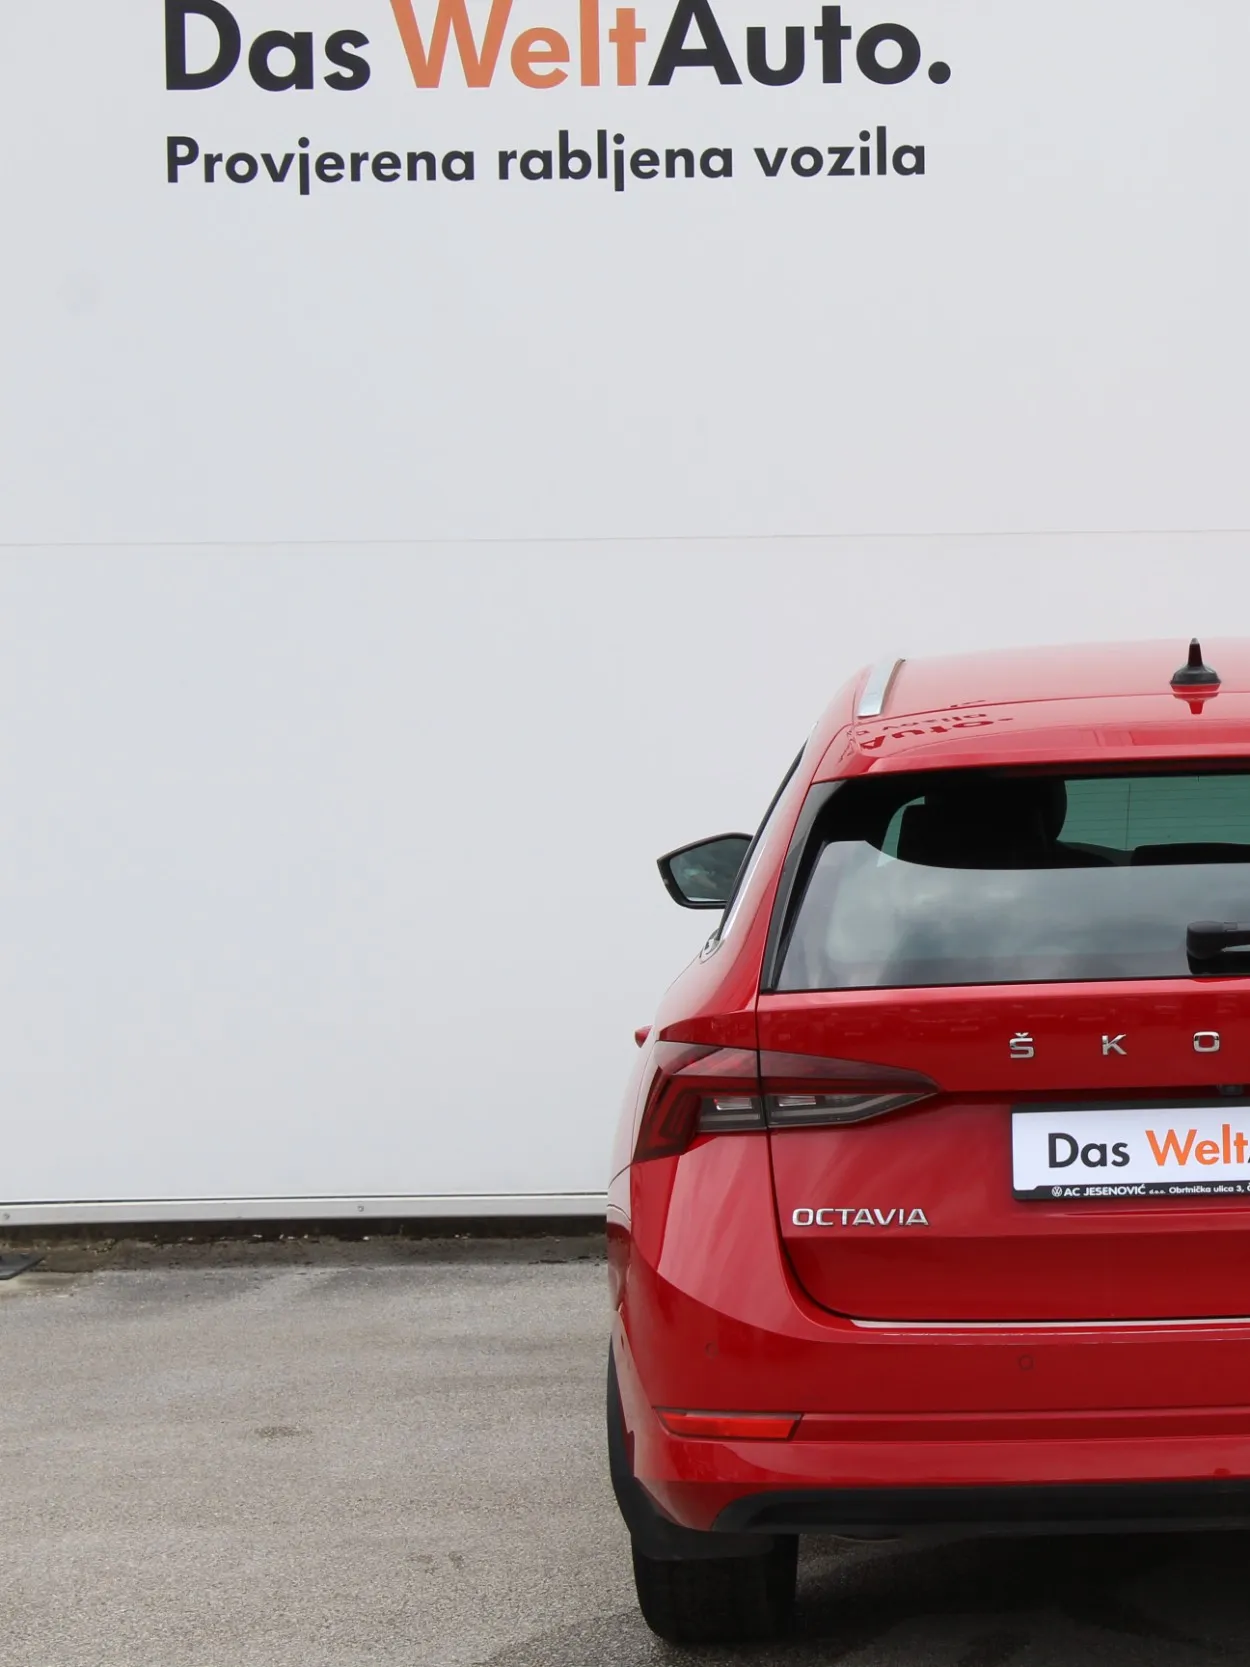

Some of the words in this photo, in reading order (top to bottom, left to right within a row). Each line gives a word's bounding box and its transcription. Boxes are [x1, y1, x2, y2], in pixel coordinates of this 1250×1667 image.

[164, 0, 371, 92] Das
[389, 0, 952, 89] WeltAuto.
[166, 135, 475, 196] Provjerena
[498, 129, 733, 192] rabljena
[753, 125, 926, 177] vozila
[1048, 1132, 1131, 1168] Das
[1063, 1187, 1081, 1197] AC
[1083, 1183, 1146, 1197] JESENOVIĆ
[1168, 1185, 1212, 1195] Obrtnička
[1213, 1184, 1234, 1193] ulica
[1236, 1185, 1245, 1193] 3,
[791, 1207, 930, 1226] OCTAVIA
